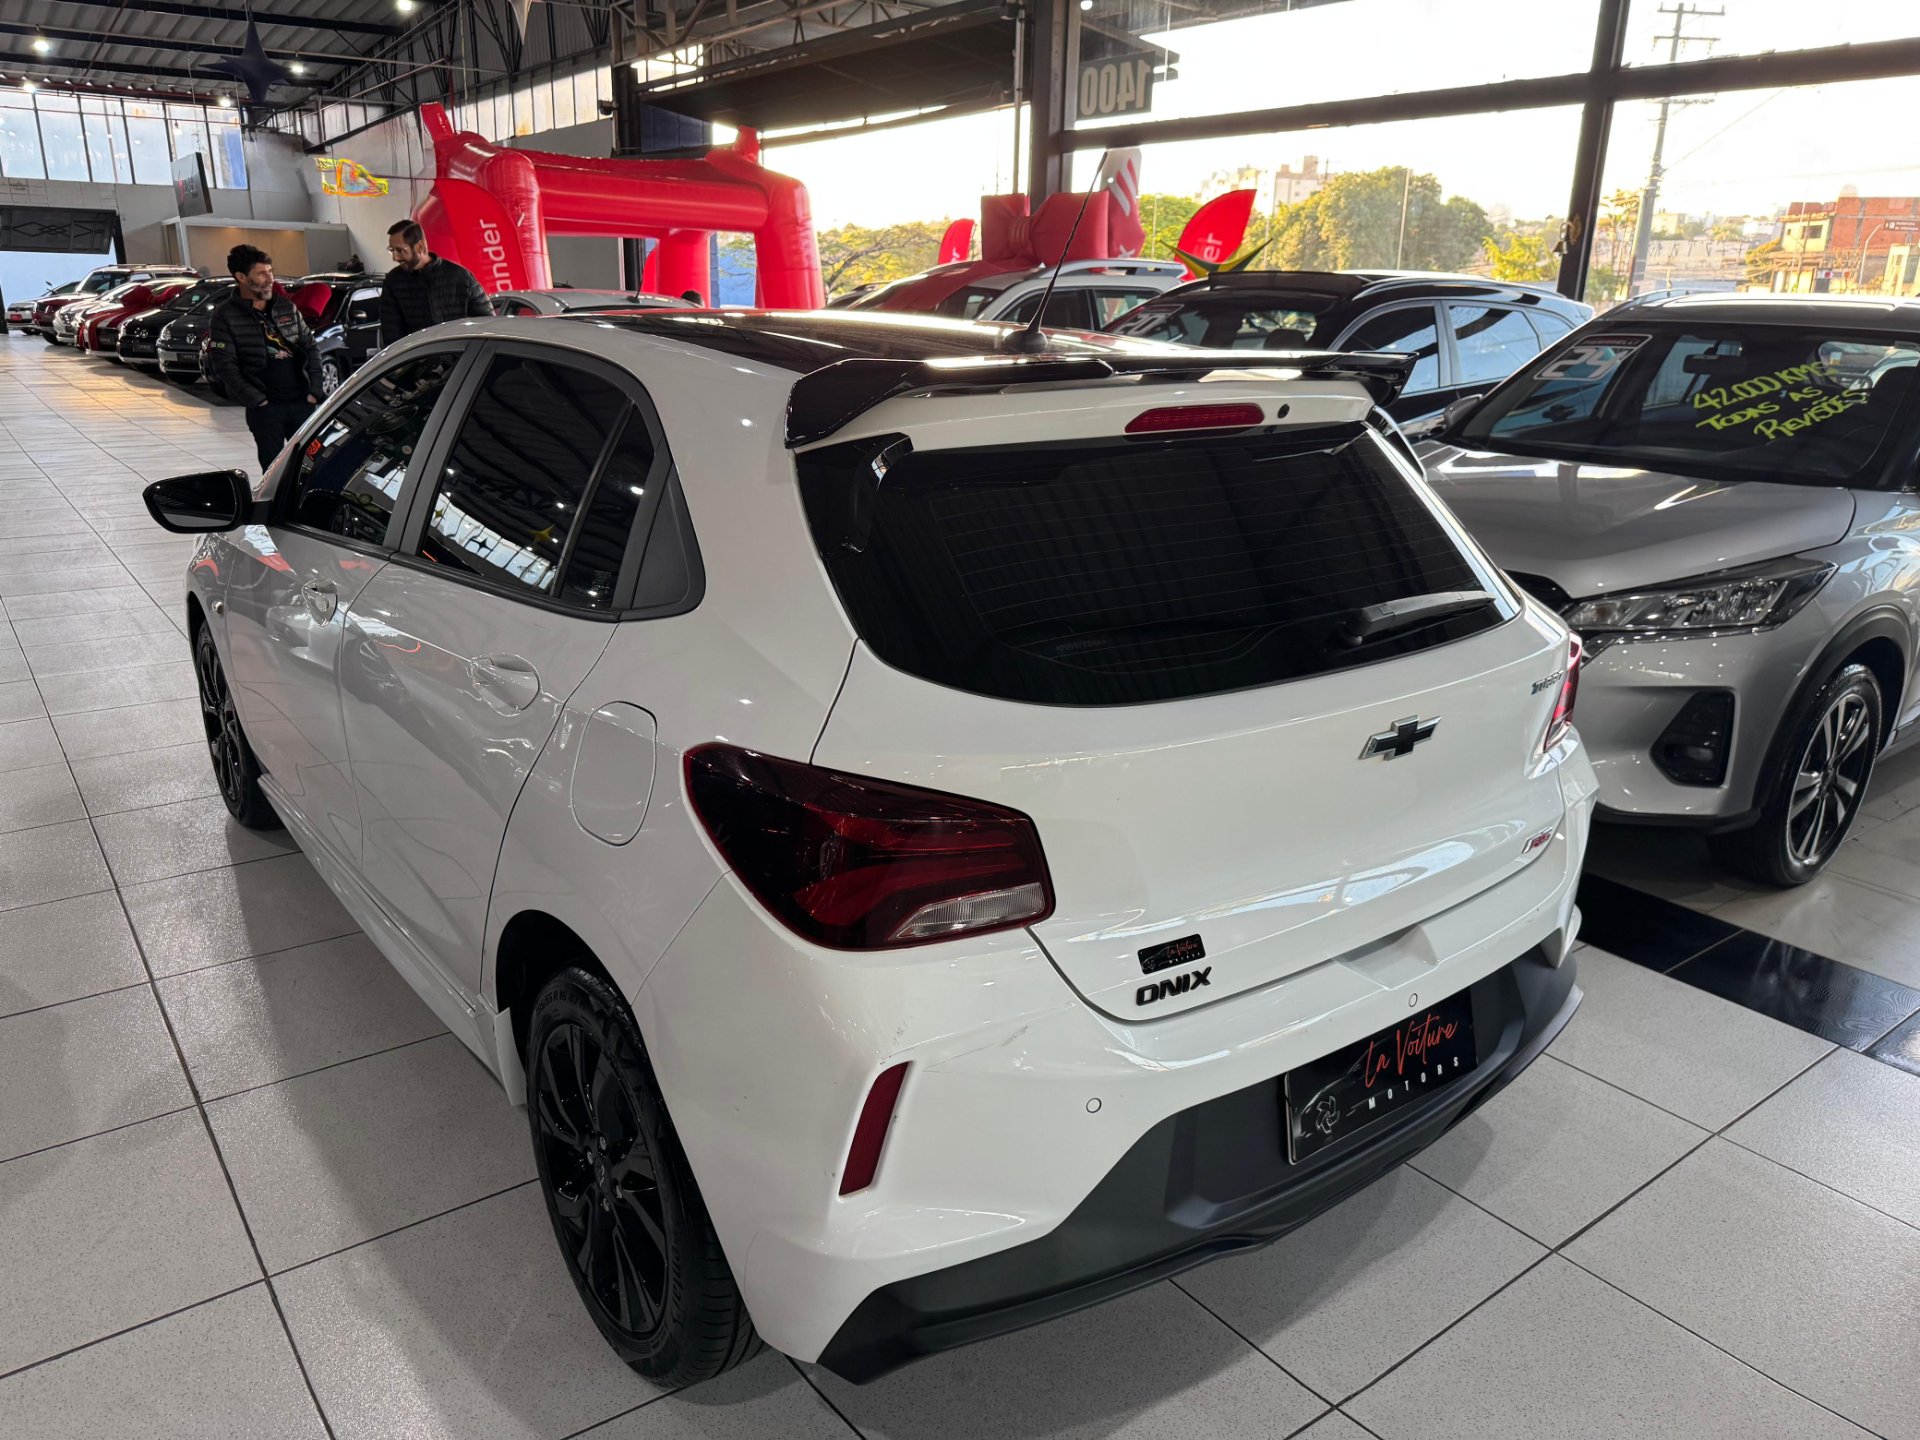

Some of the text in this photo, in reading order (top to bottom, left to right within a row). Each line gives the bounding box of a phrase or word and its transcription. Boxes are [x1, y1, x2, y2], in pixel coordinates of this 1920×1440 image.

[1789, 386, 1823, 402] AS
[1136, 966, 1212, 1006] ONIX
[1365, 1013, 1458, 1088] La Voiture
[1368, 1056, 1459, 1110] MOTORS
